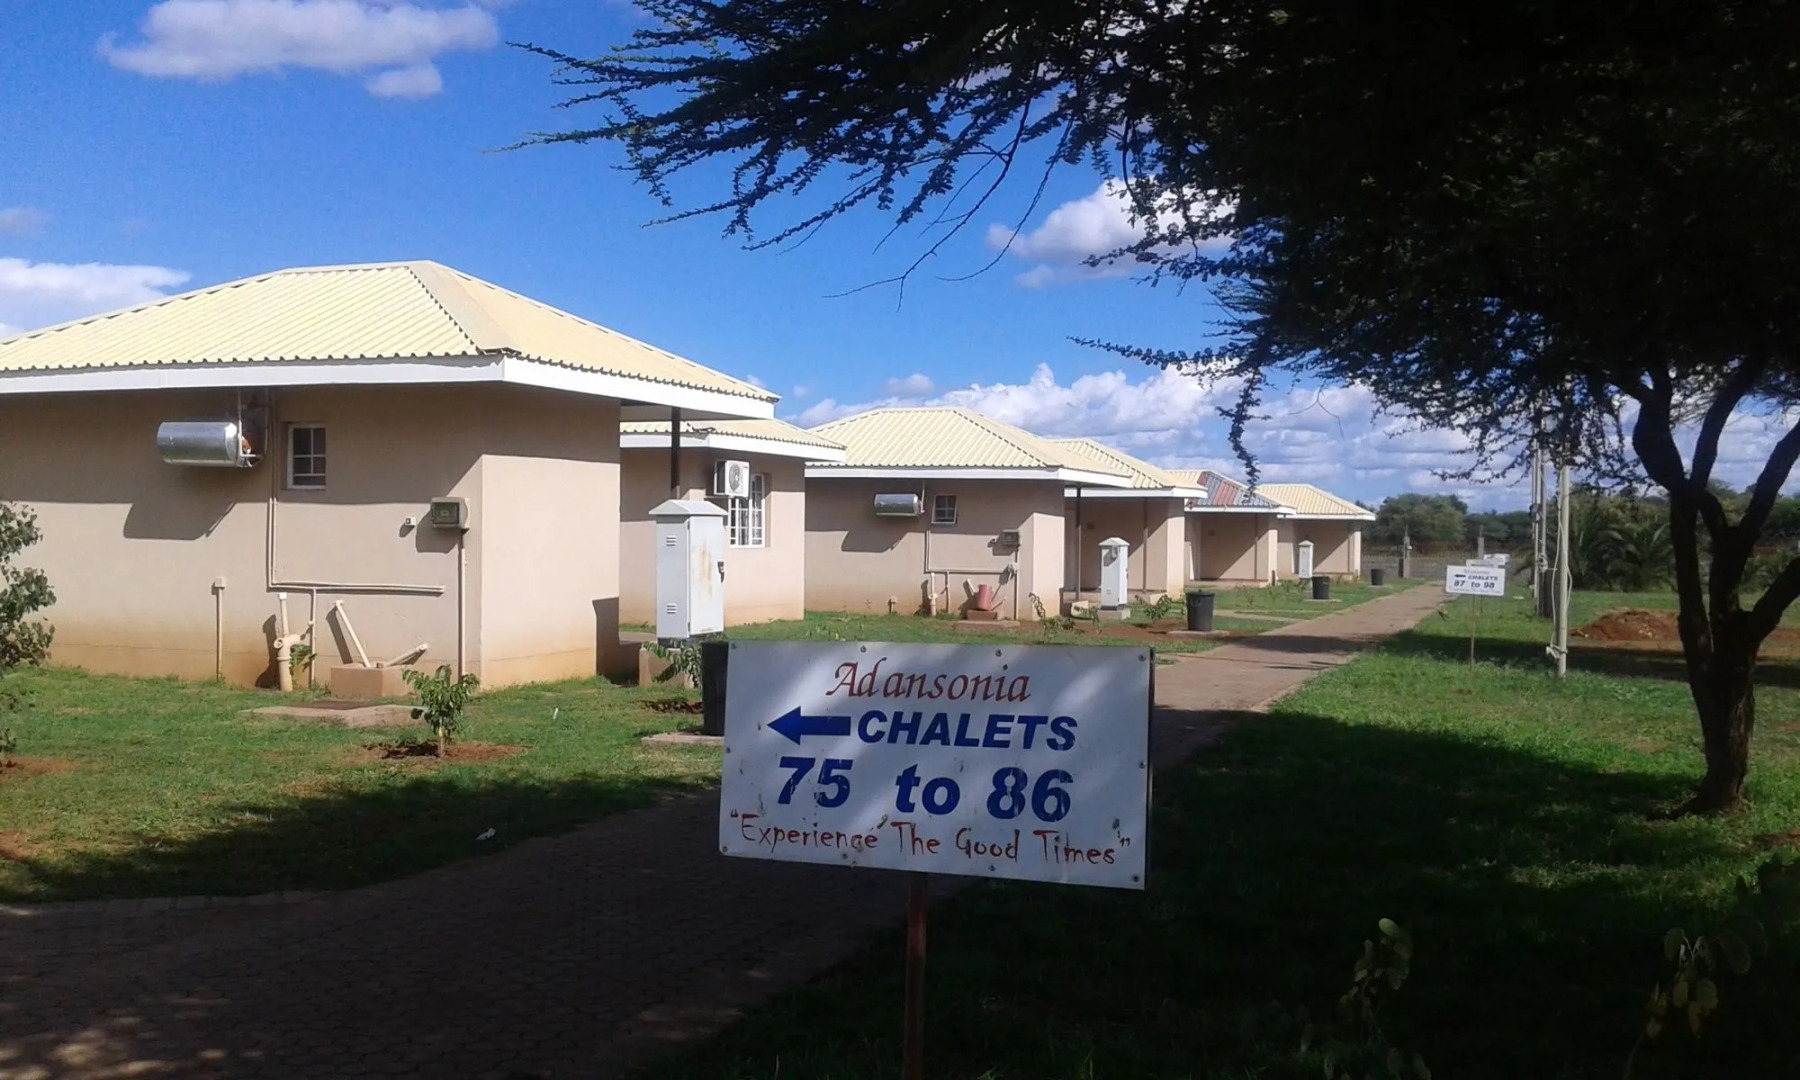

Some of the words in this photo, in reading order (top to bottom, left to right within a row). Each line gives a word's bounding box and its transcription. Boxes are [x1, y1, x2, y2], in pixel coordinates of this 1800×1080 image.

[1483, 581, 1495, 589] 98
[825, 656, 1031, 703] Adansonia
[857, 709, 1078, 751] CHALETS
[777, 755, 854, 809] 75
[895, 763, 961, 816] to
[986, 766, 1075, 823] 86
[889, 821, 941, 856] The
[955, 827, 1021, 864] Good
